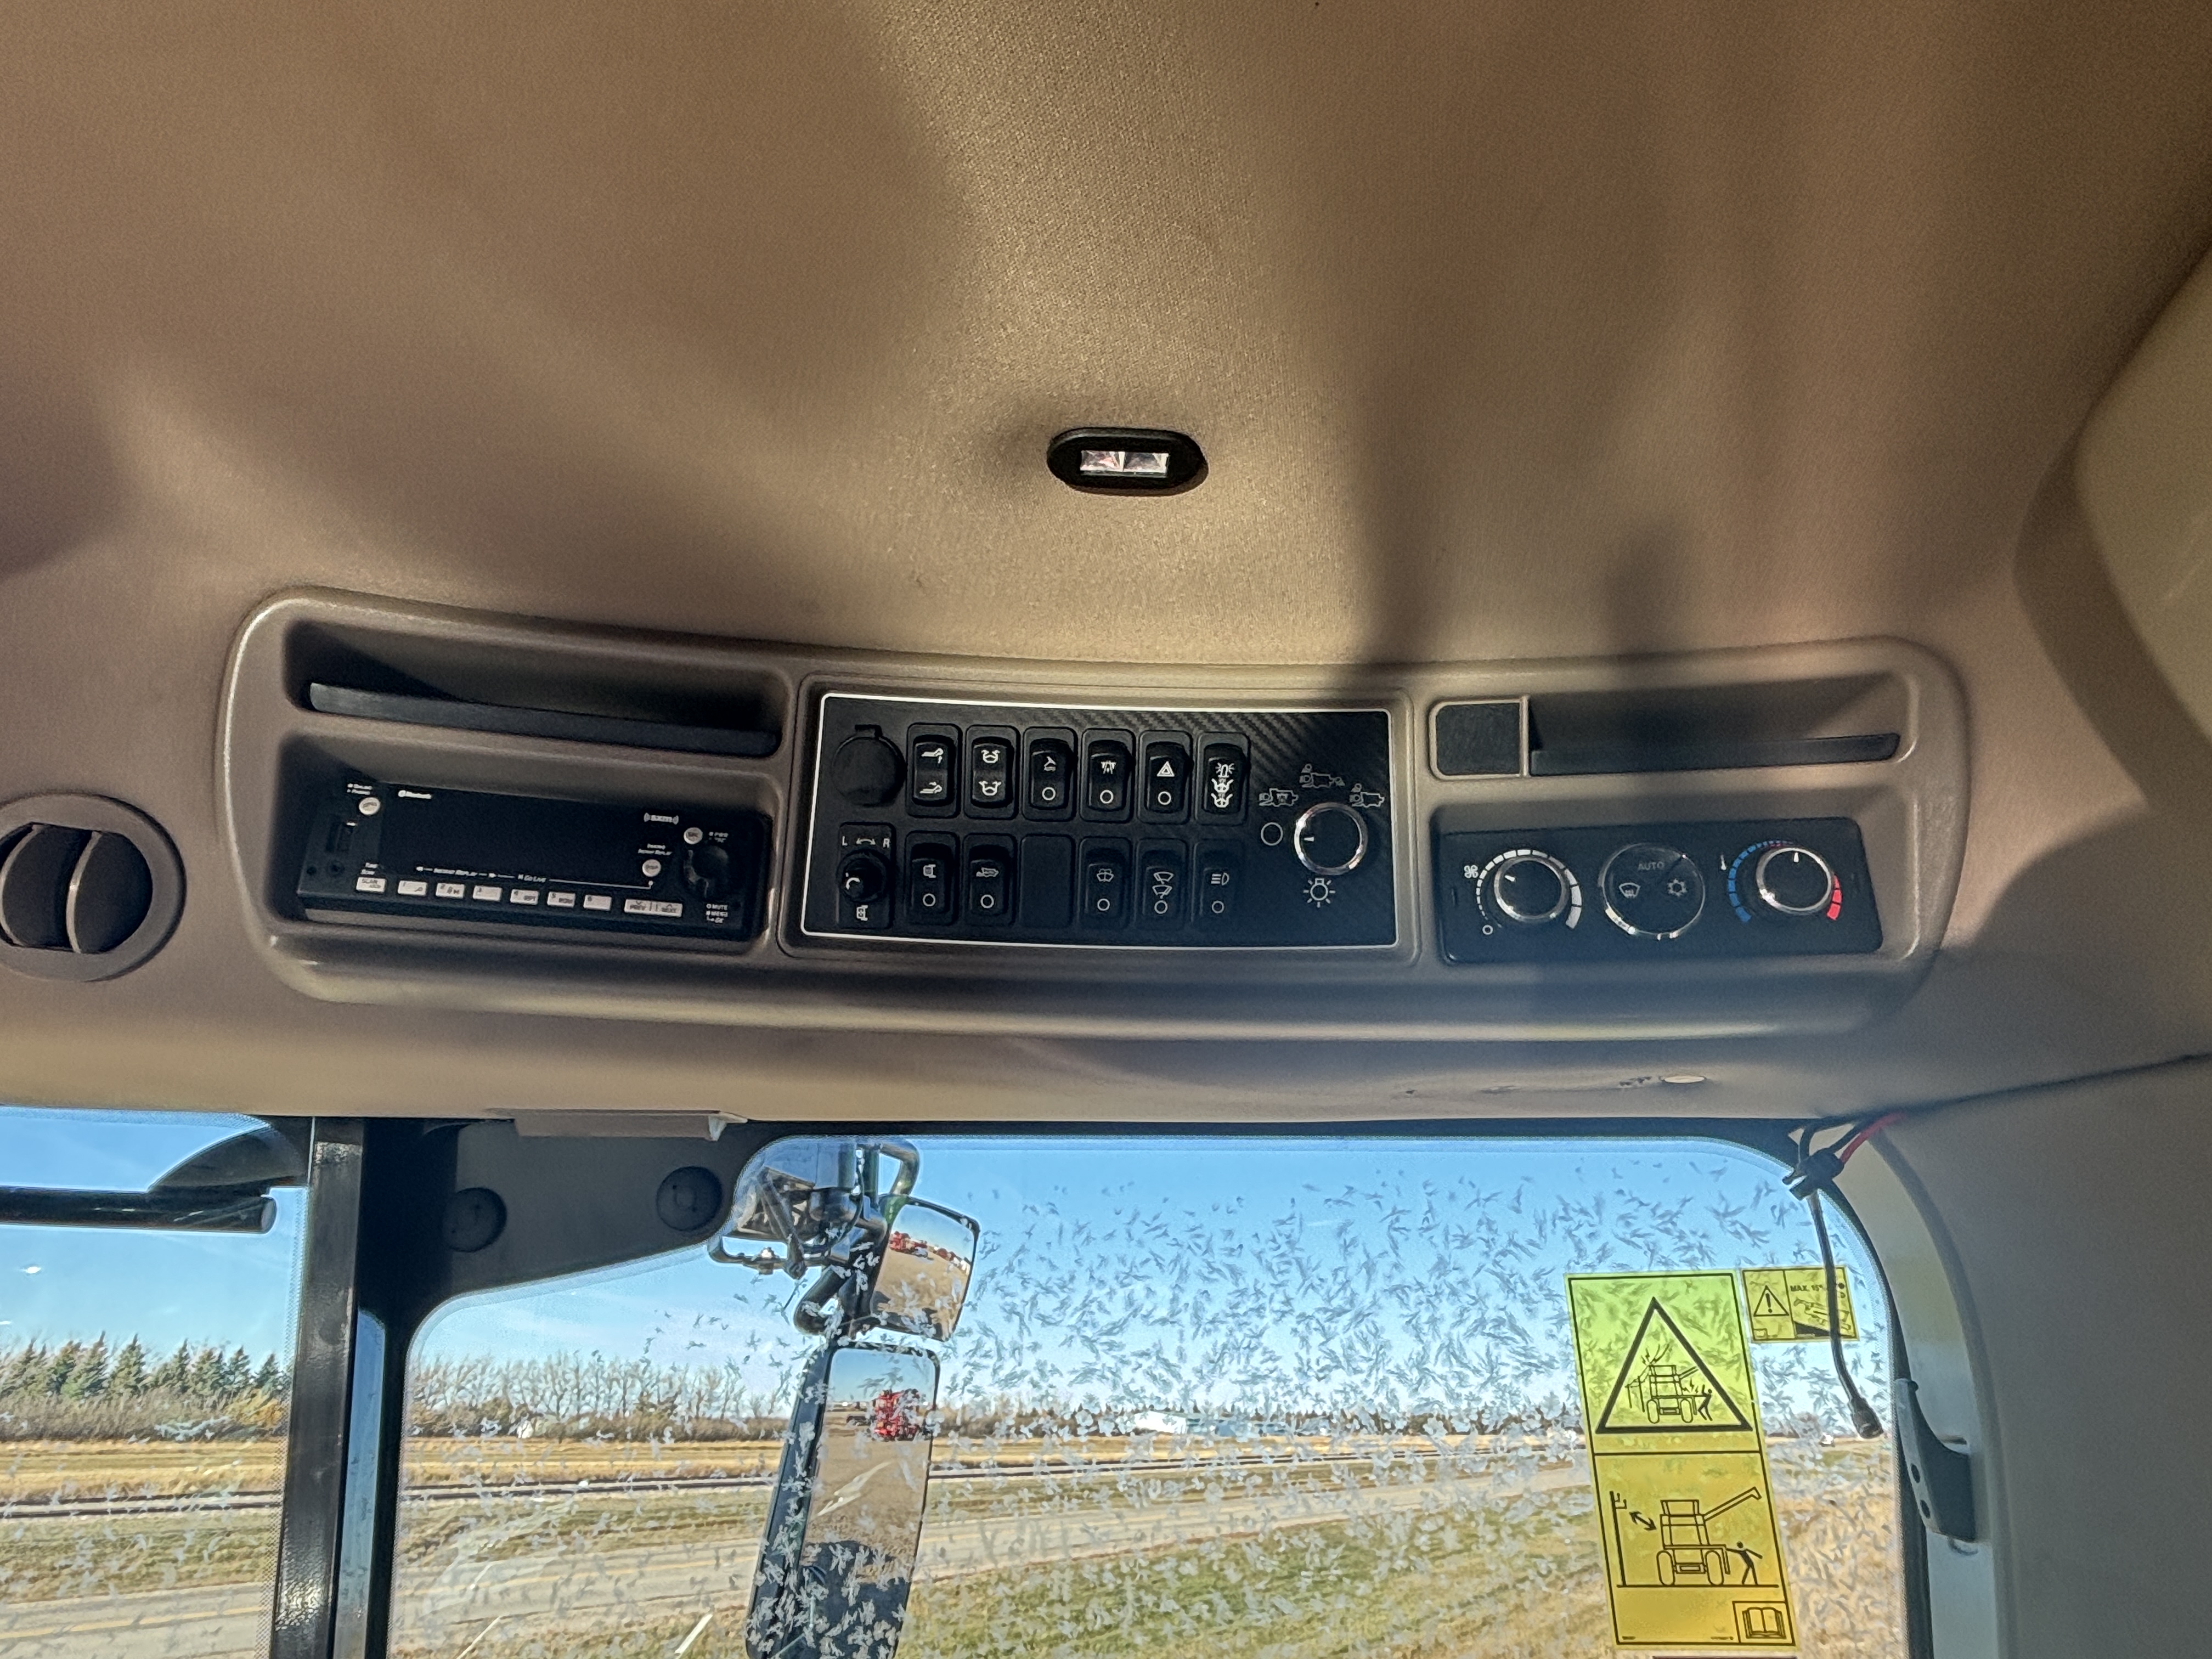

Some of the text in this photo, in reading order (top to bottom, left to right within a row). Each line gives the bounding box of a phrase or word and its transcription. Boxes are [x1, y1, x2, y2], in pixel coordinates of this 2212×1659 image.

[842, 836, 890, 848] L R
[1637, 861, 1664, 871] AUTO
